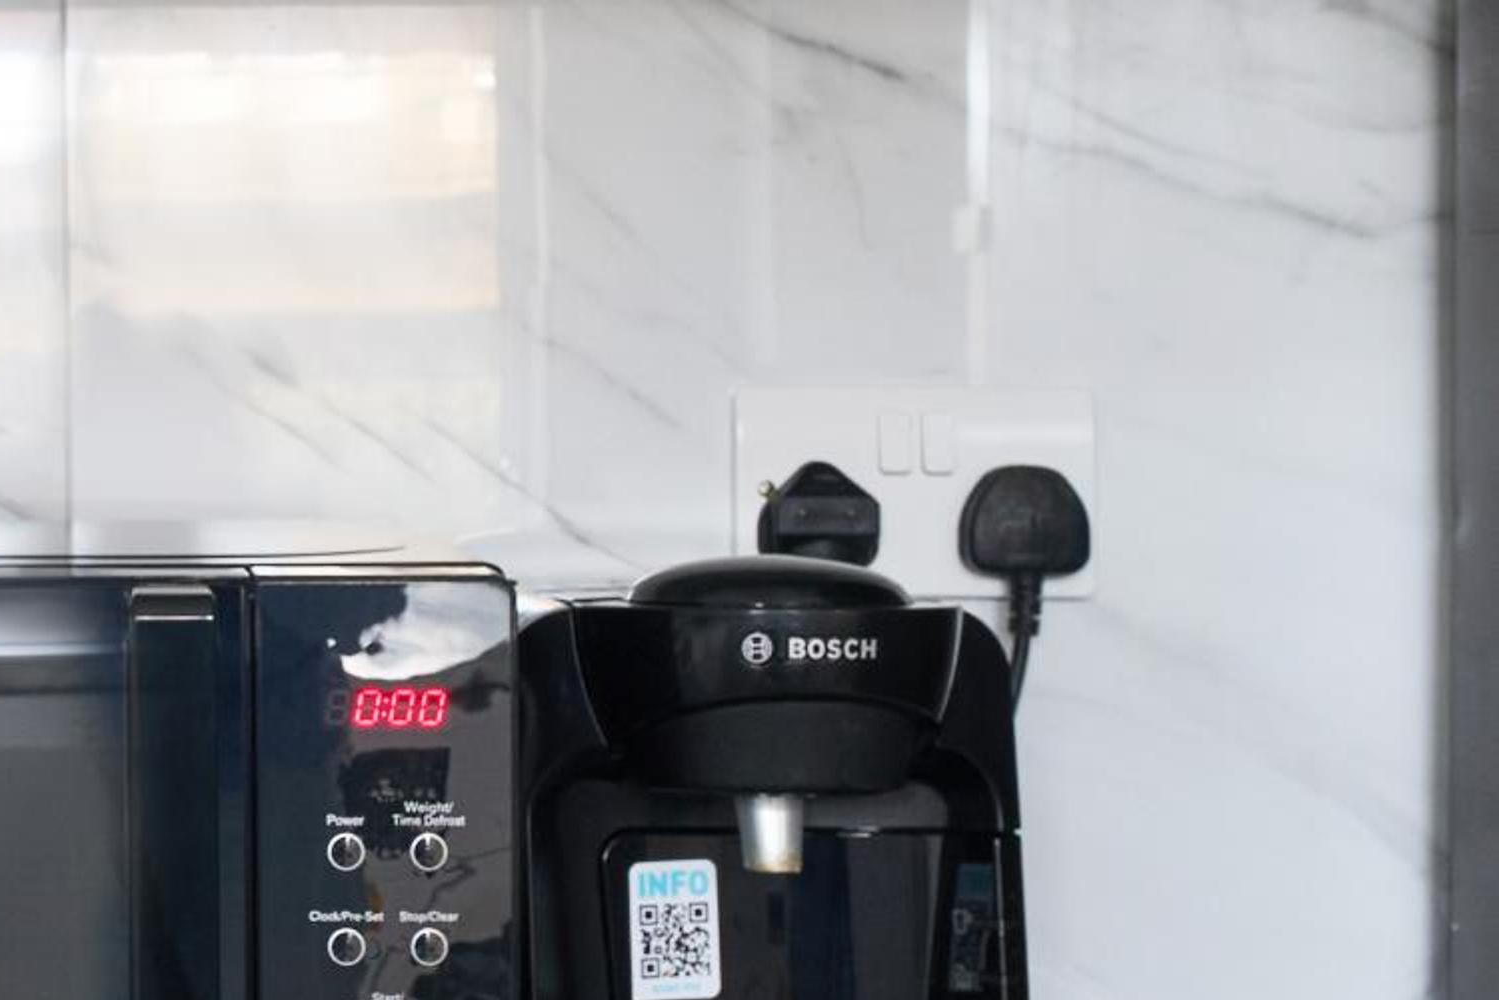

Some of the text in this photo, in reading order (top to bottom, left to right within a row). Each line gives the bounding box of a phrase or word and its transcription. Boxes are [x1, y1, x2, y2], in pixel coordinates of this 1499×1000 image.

[788, 637, 878, 660] BOSCH
[354, 688, 447, 726] 0:00
[326, 815, 364, 827] Power
[393, 813, 466, 827] Time Defrost
[637, 870, 710, 897] INFO
[399, 910, 459, 924] Stop/Clear
